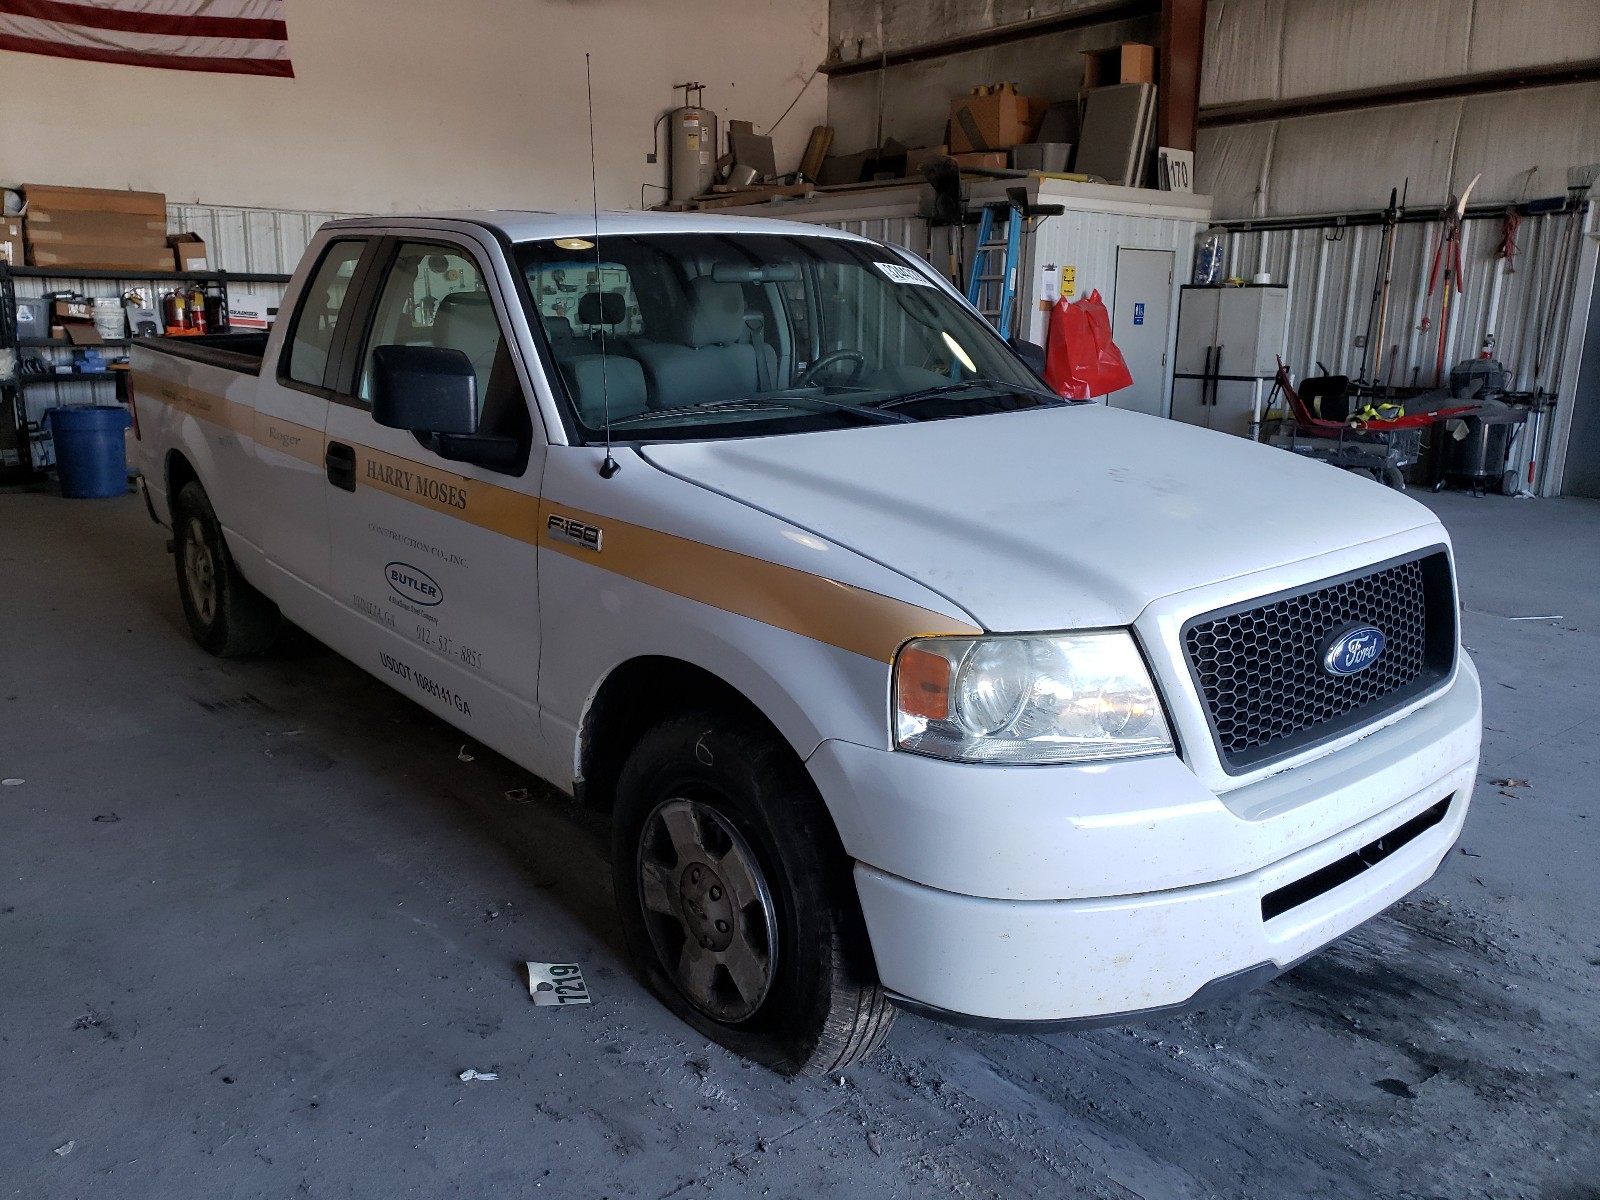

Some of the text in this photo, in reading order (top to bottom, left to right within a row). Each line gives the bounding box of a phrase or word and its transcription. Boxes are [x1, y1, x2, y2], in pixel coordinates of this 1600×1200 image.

[268, 426, 302, 448] Roger
[366, 459, 467, 510] HARRY MOSES
[391, 570, 437, 598] BUTLER
[1345, 634, 1377, 667] Ford
[379, 651, 473, 718] USDOT 1086141 GA
[549, 965, 589, 1004] 7219
